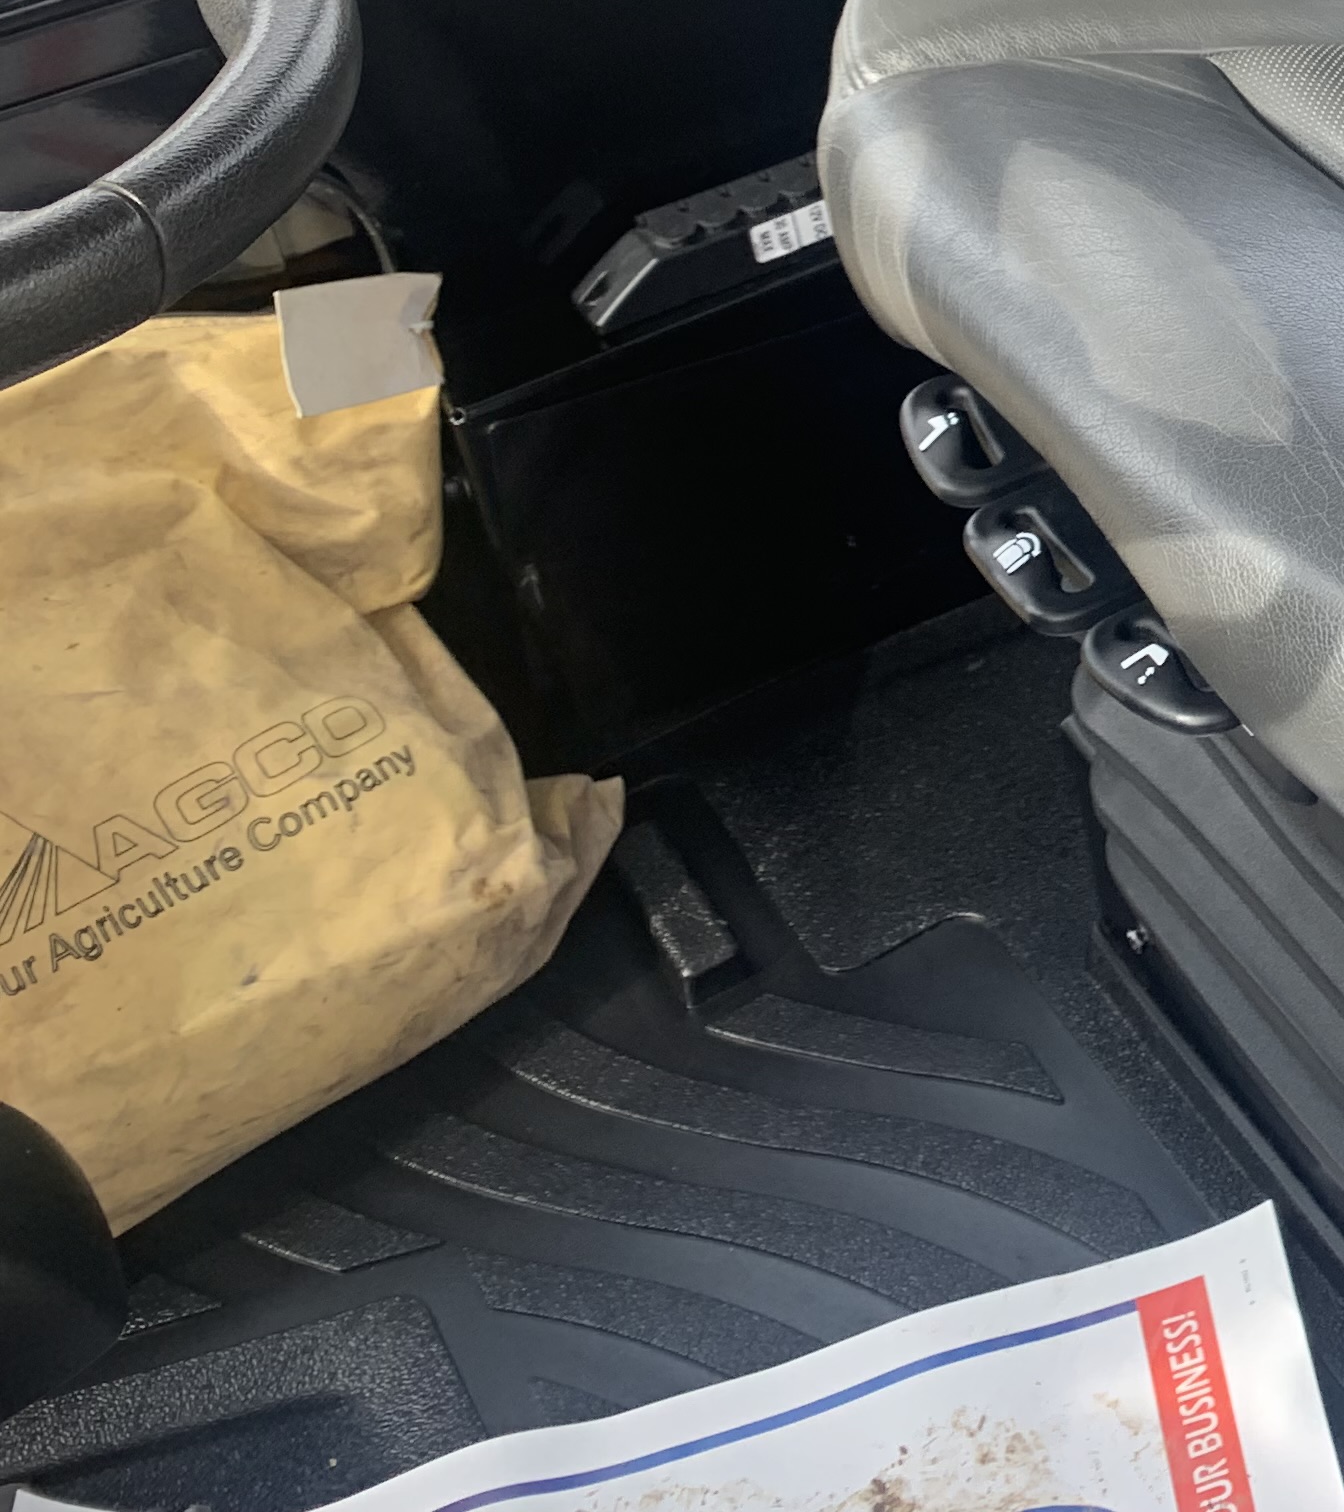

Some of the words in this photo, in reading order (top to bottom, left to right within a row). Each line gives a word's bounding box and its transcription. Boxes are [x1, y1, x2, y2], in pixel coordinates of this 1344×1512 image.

[49, 846, 245, 972] Agriculture
[246, 744, 417, 852] Company
[93, 695, 387, 878] AGCO
[1161, 1309, 1225, 1460] BUSINESS!
